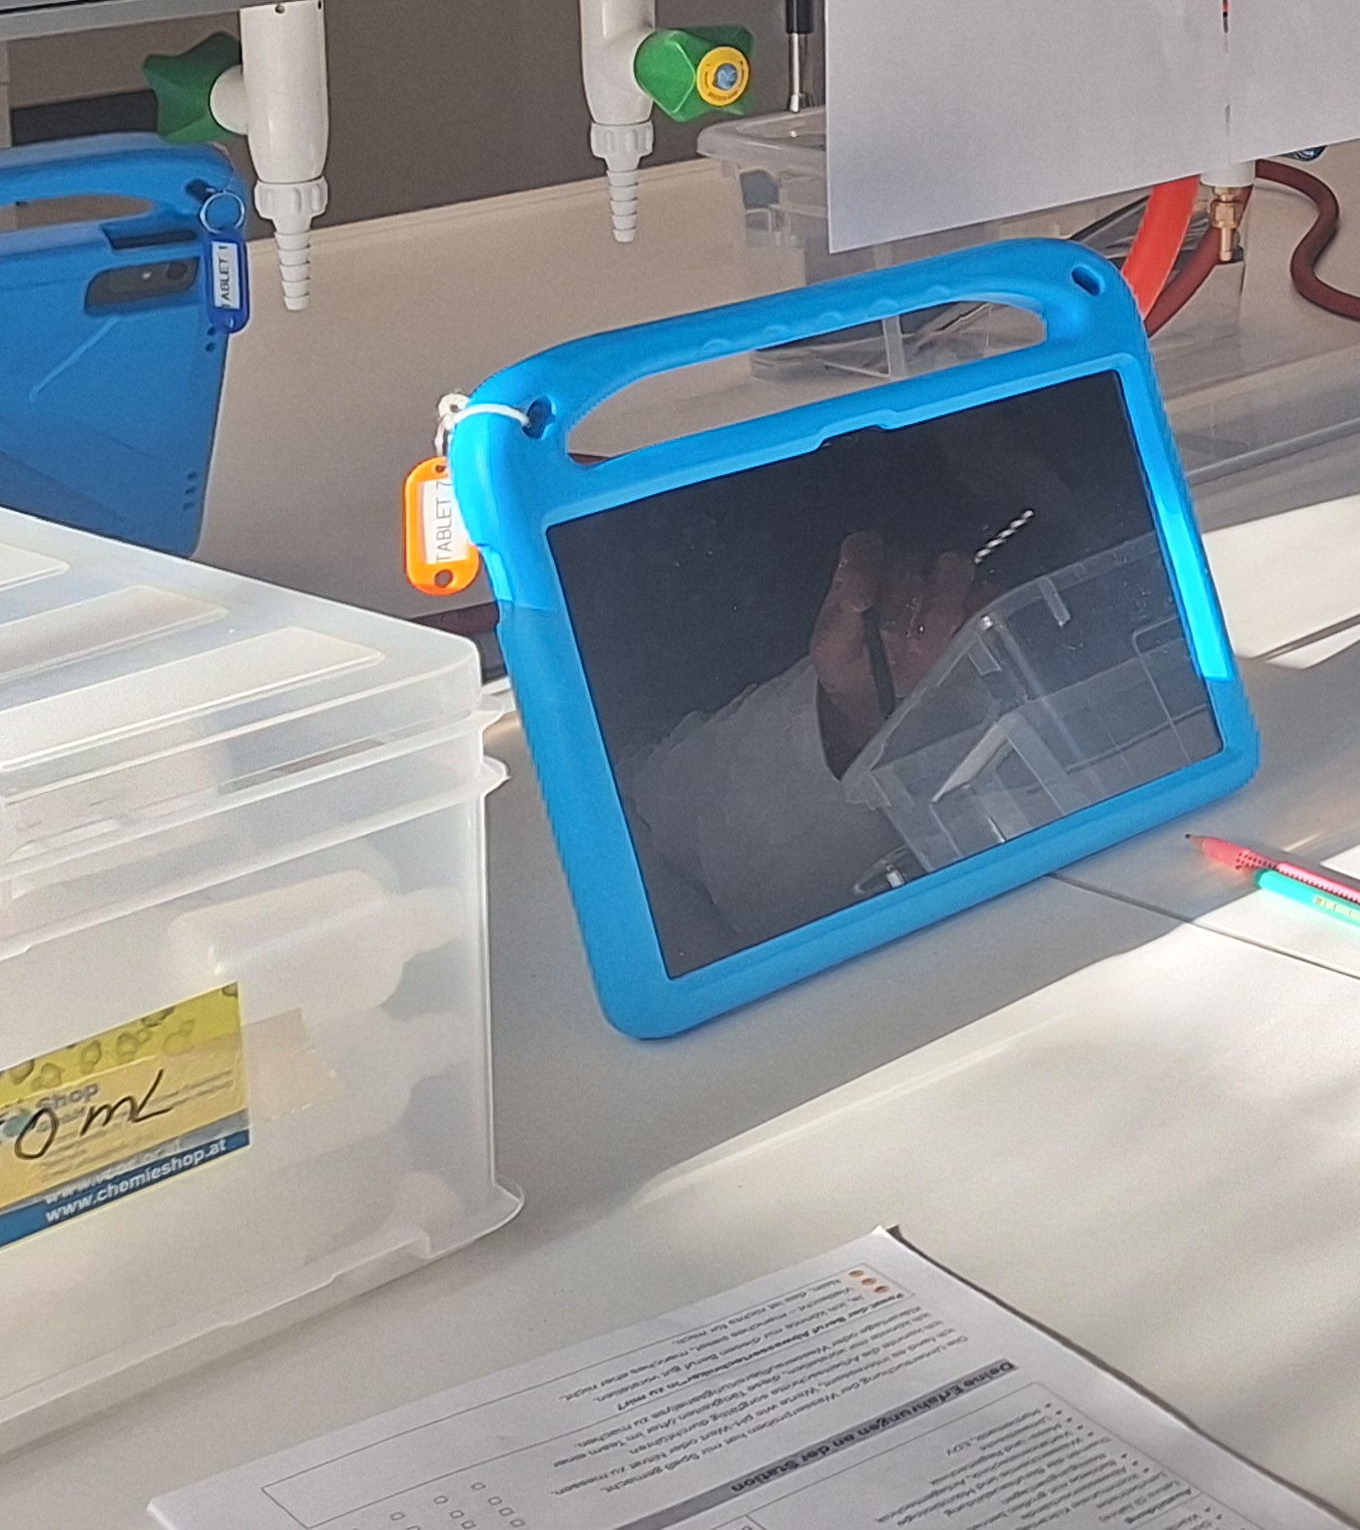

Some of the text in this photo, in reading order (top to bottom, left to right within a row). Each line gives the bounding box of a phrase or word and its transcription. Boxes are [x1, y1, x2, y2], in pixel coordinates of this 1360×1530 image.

[219, 257, 231, 308] TABLET
[436, 497, 452, 561] TABLET
[46, 1138, 227, 1222] www.chemieshop.at
[963, 1362, 1014, 1387] Deine
[857, 1385, 964, 1435] Erfahrungen
[731, 1460, 799, 1491] Station
